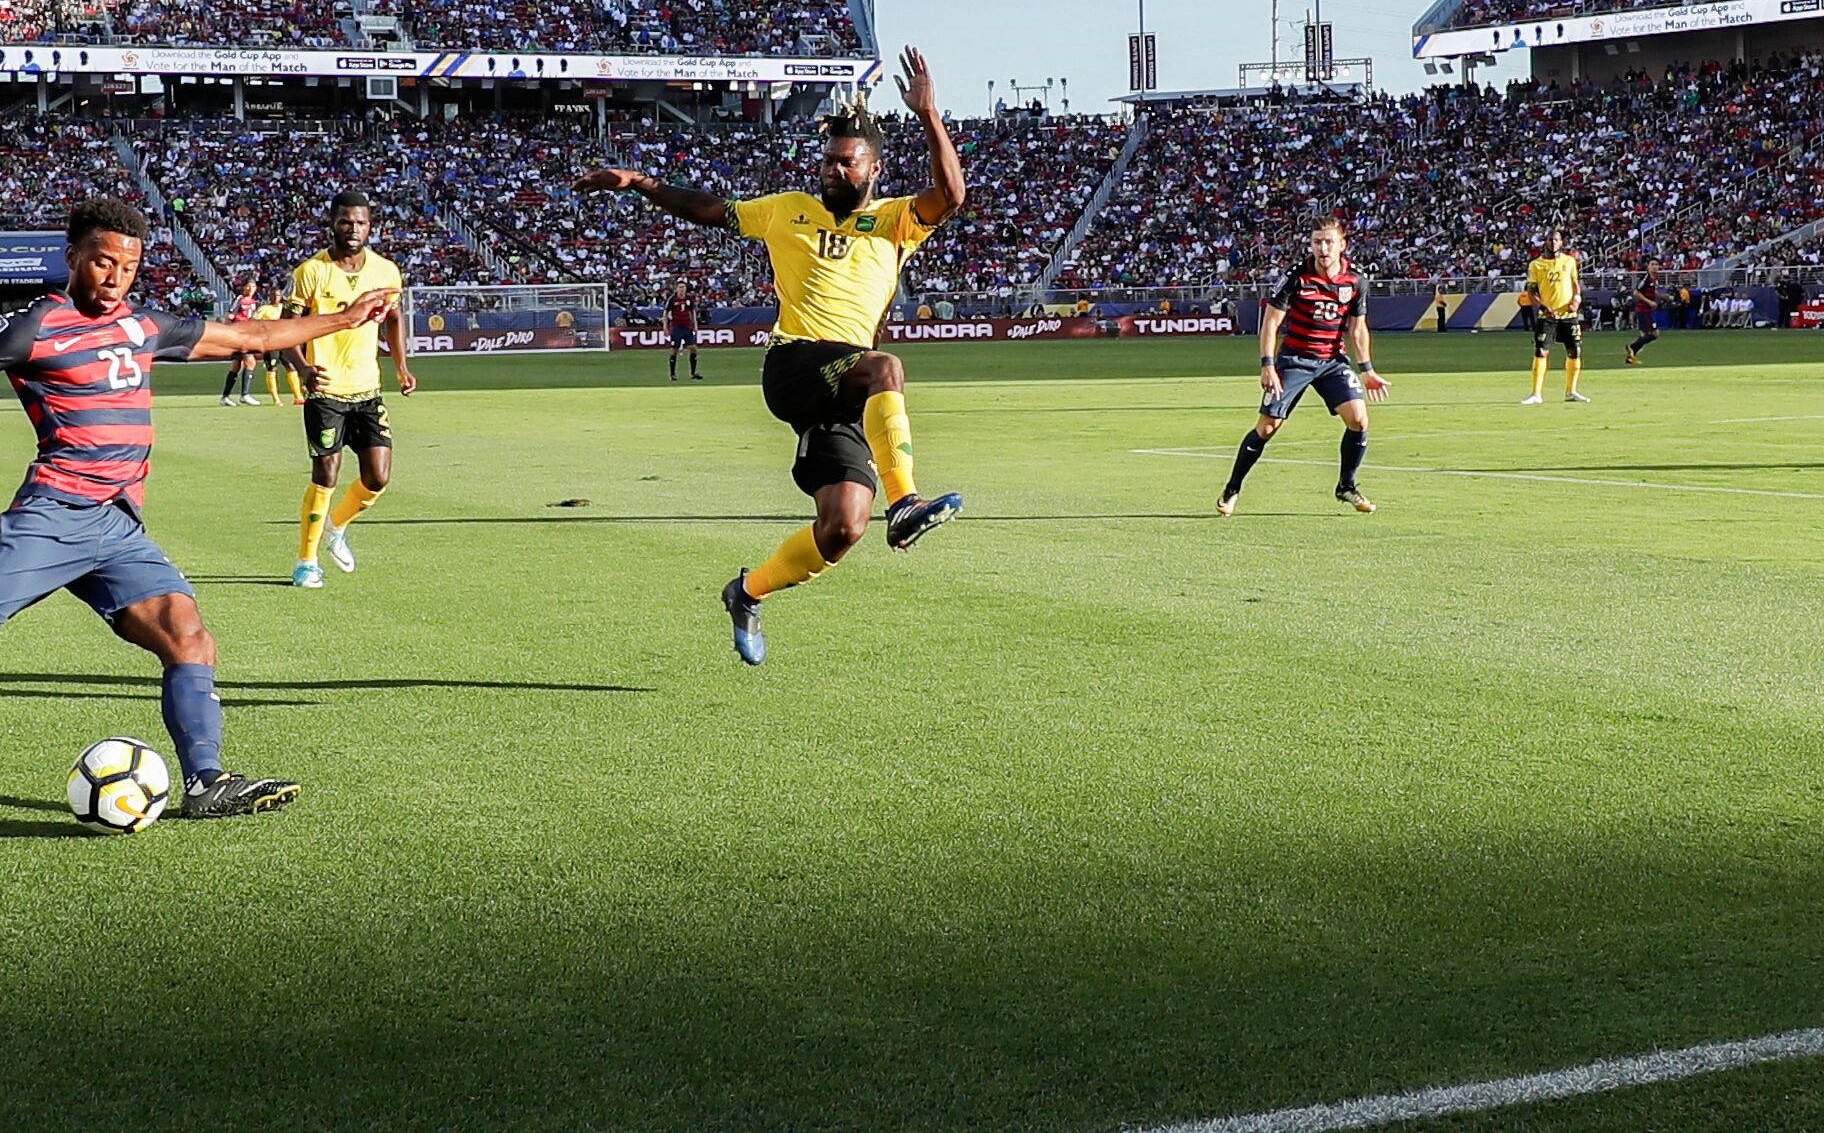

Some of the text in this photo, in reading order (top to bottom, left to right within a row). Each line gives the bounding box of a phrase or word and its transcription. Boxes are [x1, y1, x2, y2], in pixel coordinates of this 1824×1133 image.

[1667, 6, 1688, 18] Gold
[1690, 5, 1708, 18] Cup
[1710, 3, 1729, 16] App
[1665, 19, 1688, 31] Man
[1719, 11, 1753, 25] Match
[10, 245, 61, 254] CUP
[816, 228, 848, 260] 18
[887, 323, 994, 340] TUNDRA
[1036, 318, 1062, 335] DURO
[1133, 317, 1233, 333] TUNDRA
[503, 330, 534, 347] DURO
[97, 346, 143, 390] 23
